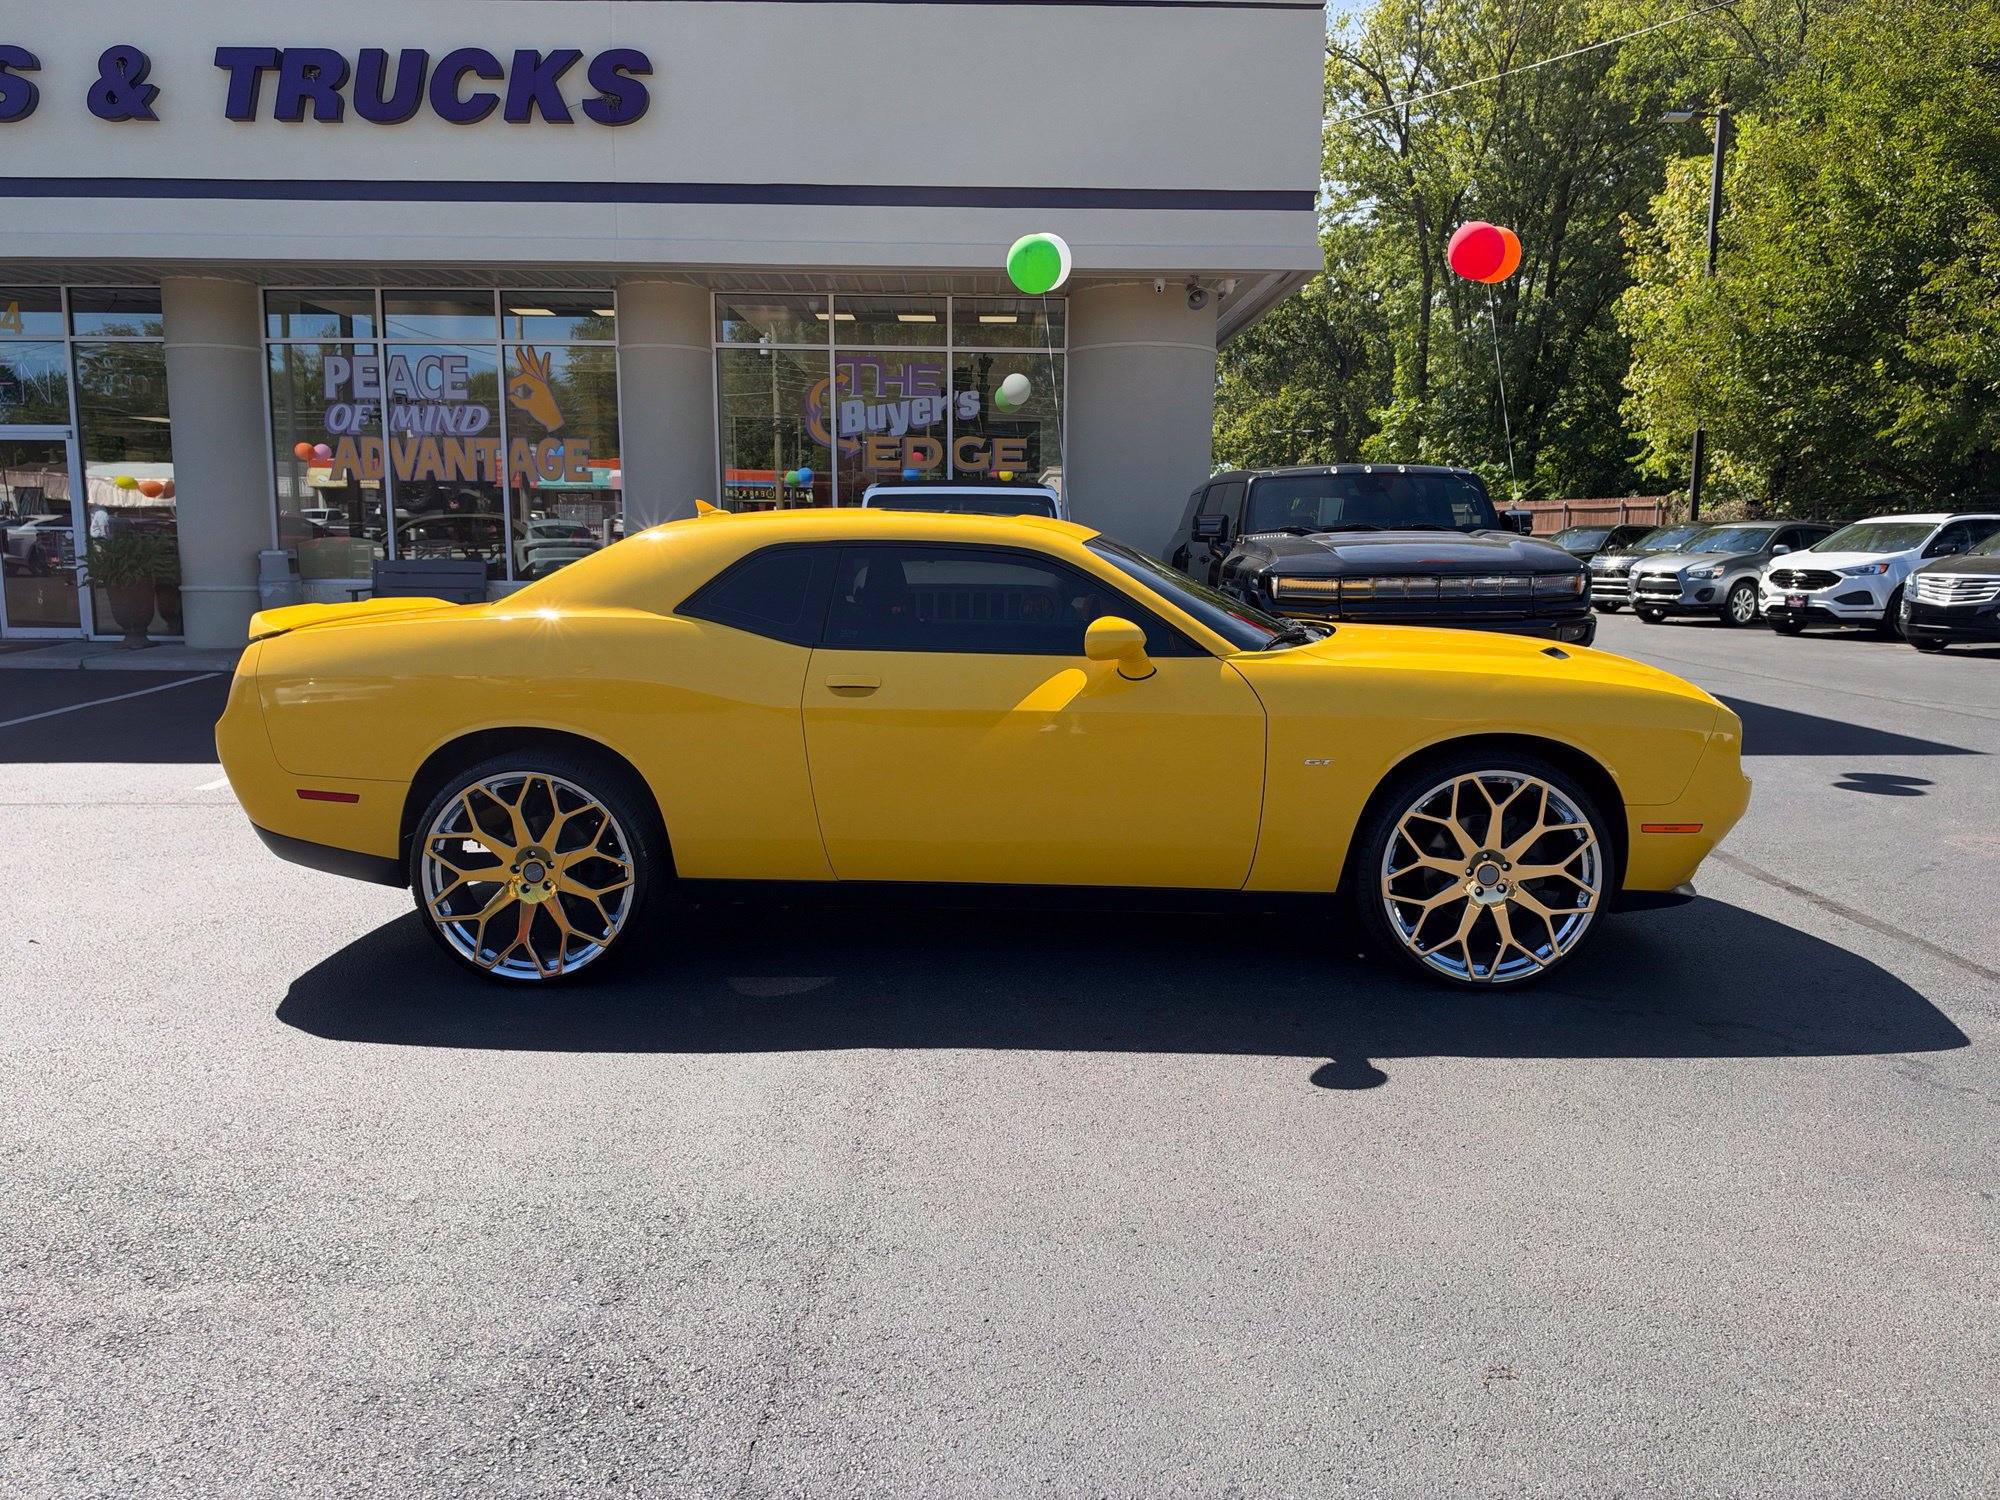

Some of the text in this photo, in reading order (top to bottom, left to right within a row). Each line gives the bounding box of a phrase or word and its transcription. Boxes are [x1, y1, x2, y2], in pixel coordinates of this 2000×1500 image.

[87, 44, 160, 121] &
[214, 46, 654, 127] TRUCKS
[322, 355, 469, 400] PEACE
[836, 354, 942, 398] THE
[324, 403, 490, 436] OF MIND
[839, 389, 980, 437] Buyer's
[330, 436, 593, 482] ADVANTAGE
[864, 436, 1028, 472] EDGE
